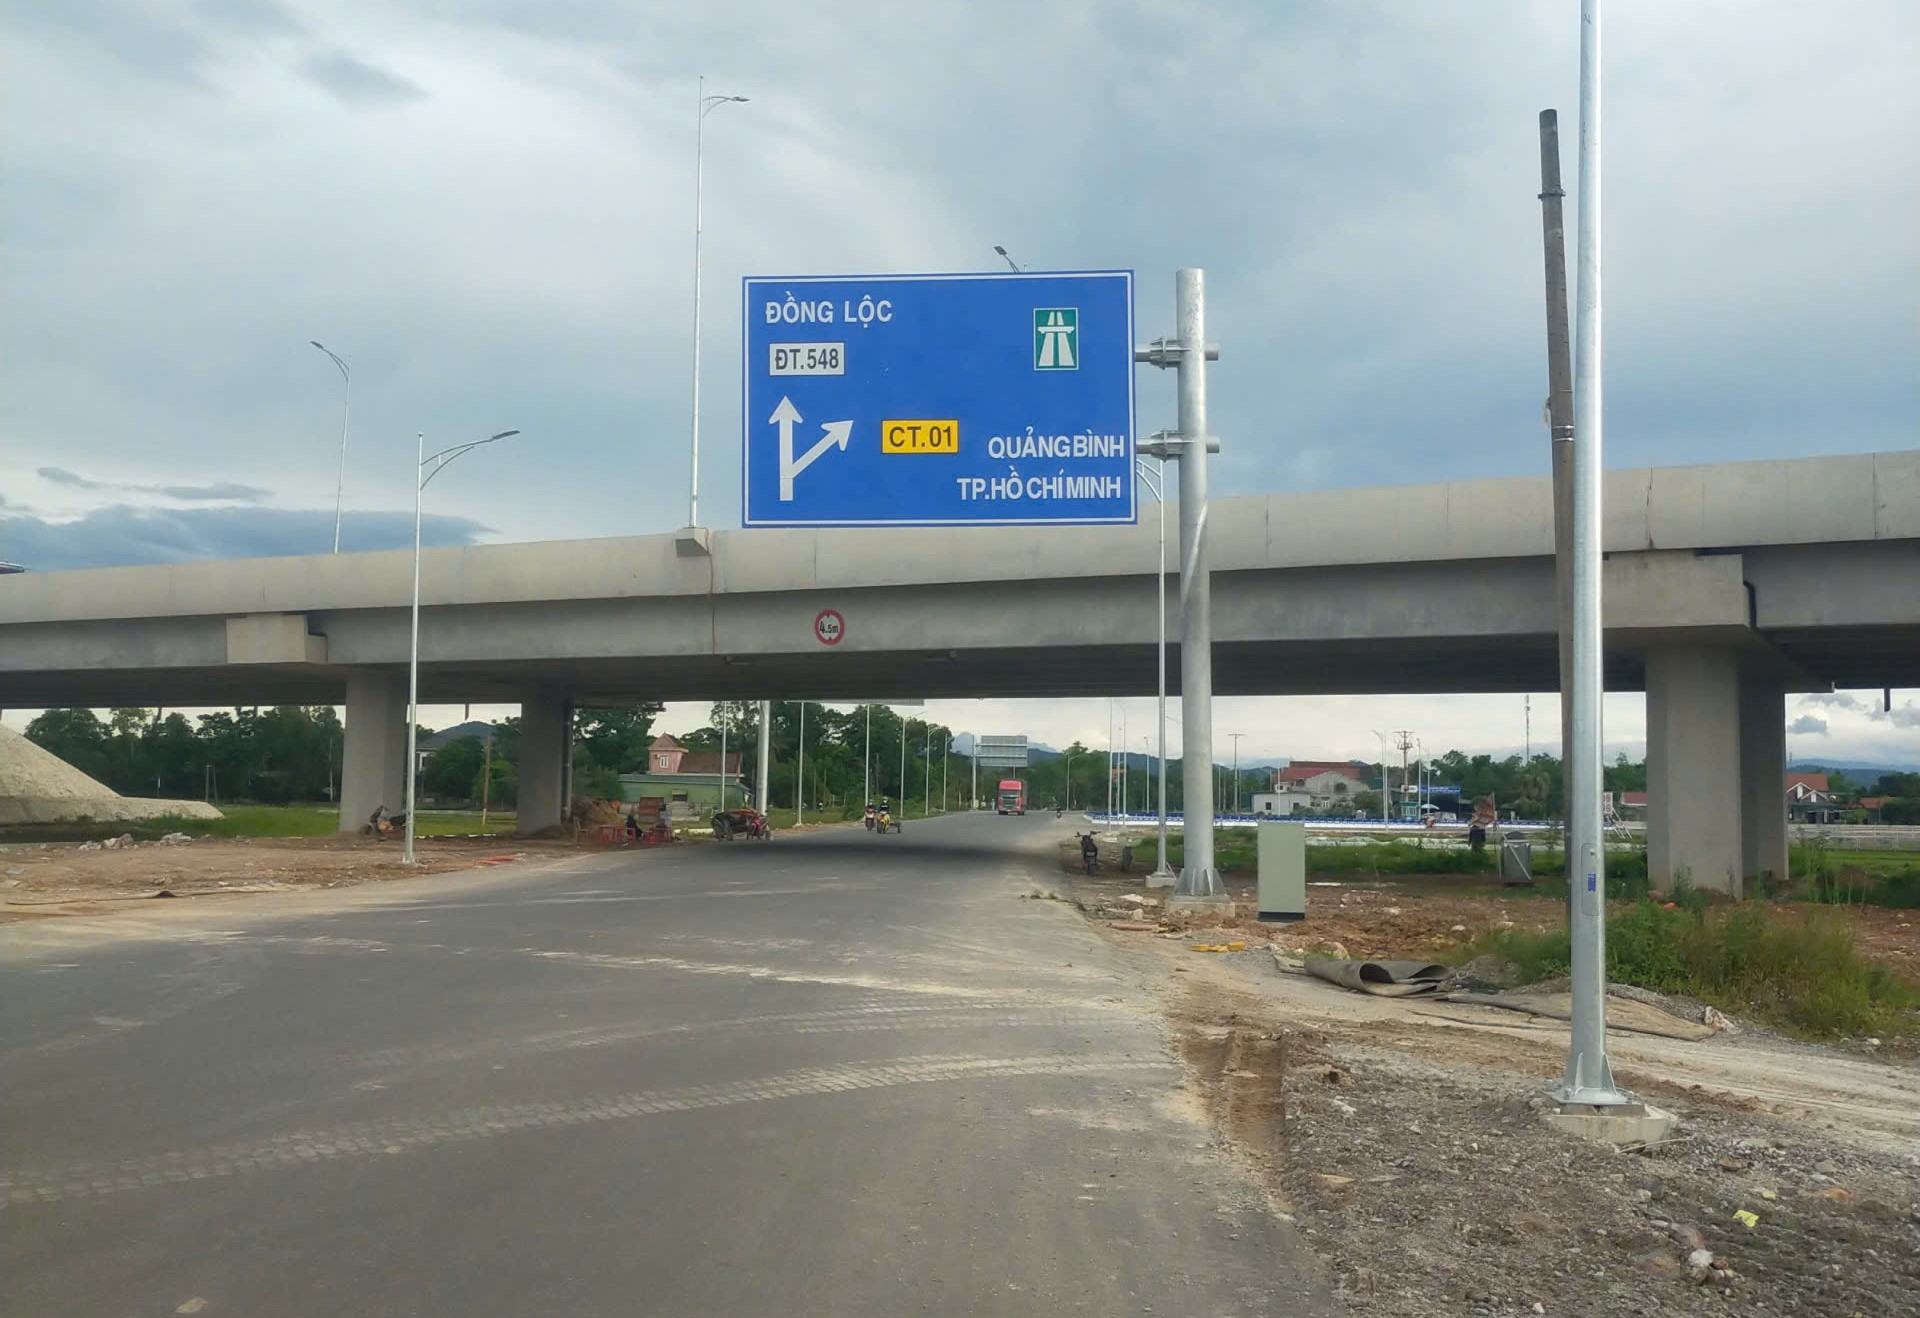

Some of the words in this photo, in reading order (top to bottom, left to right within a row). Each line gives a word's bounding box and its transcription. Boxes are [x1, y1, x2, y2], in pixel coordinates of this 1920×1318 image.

[765, 290, 834, 324] ĐỒNG
[844, 294, 893, 329] LỘC
[774, 348, 839, 370] ĐT.548
[889, 425, 952, 448] CT.01
[988, 425, 1071, 459] QUẢNG
[1073, 428, 1125, 458] BÌNH
[1026, 468, 1063, 499] CHÍ
[1066, 476, 1121, 499] MINH
[819, 621, 839, 634] 4.5m
